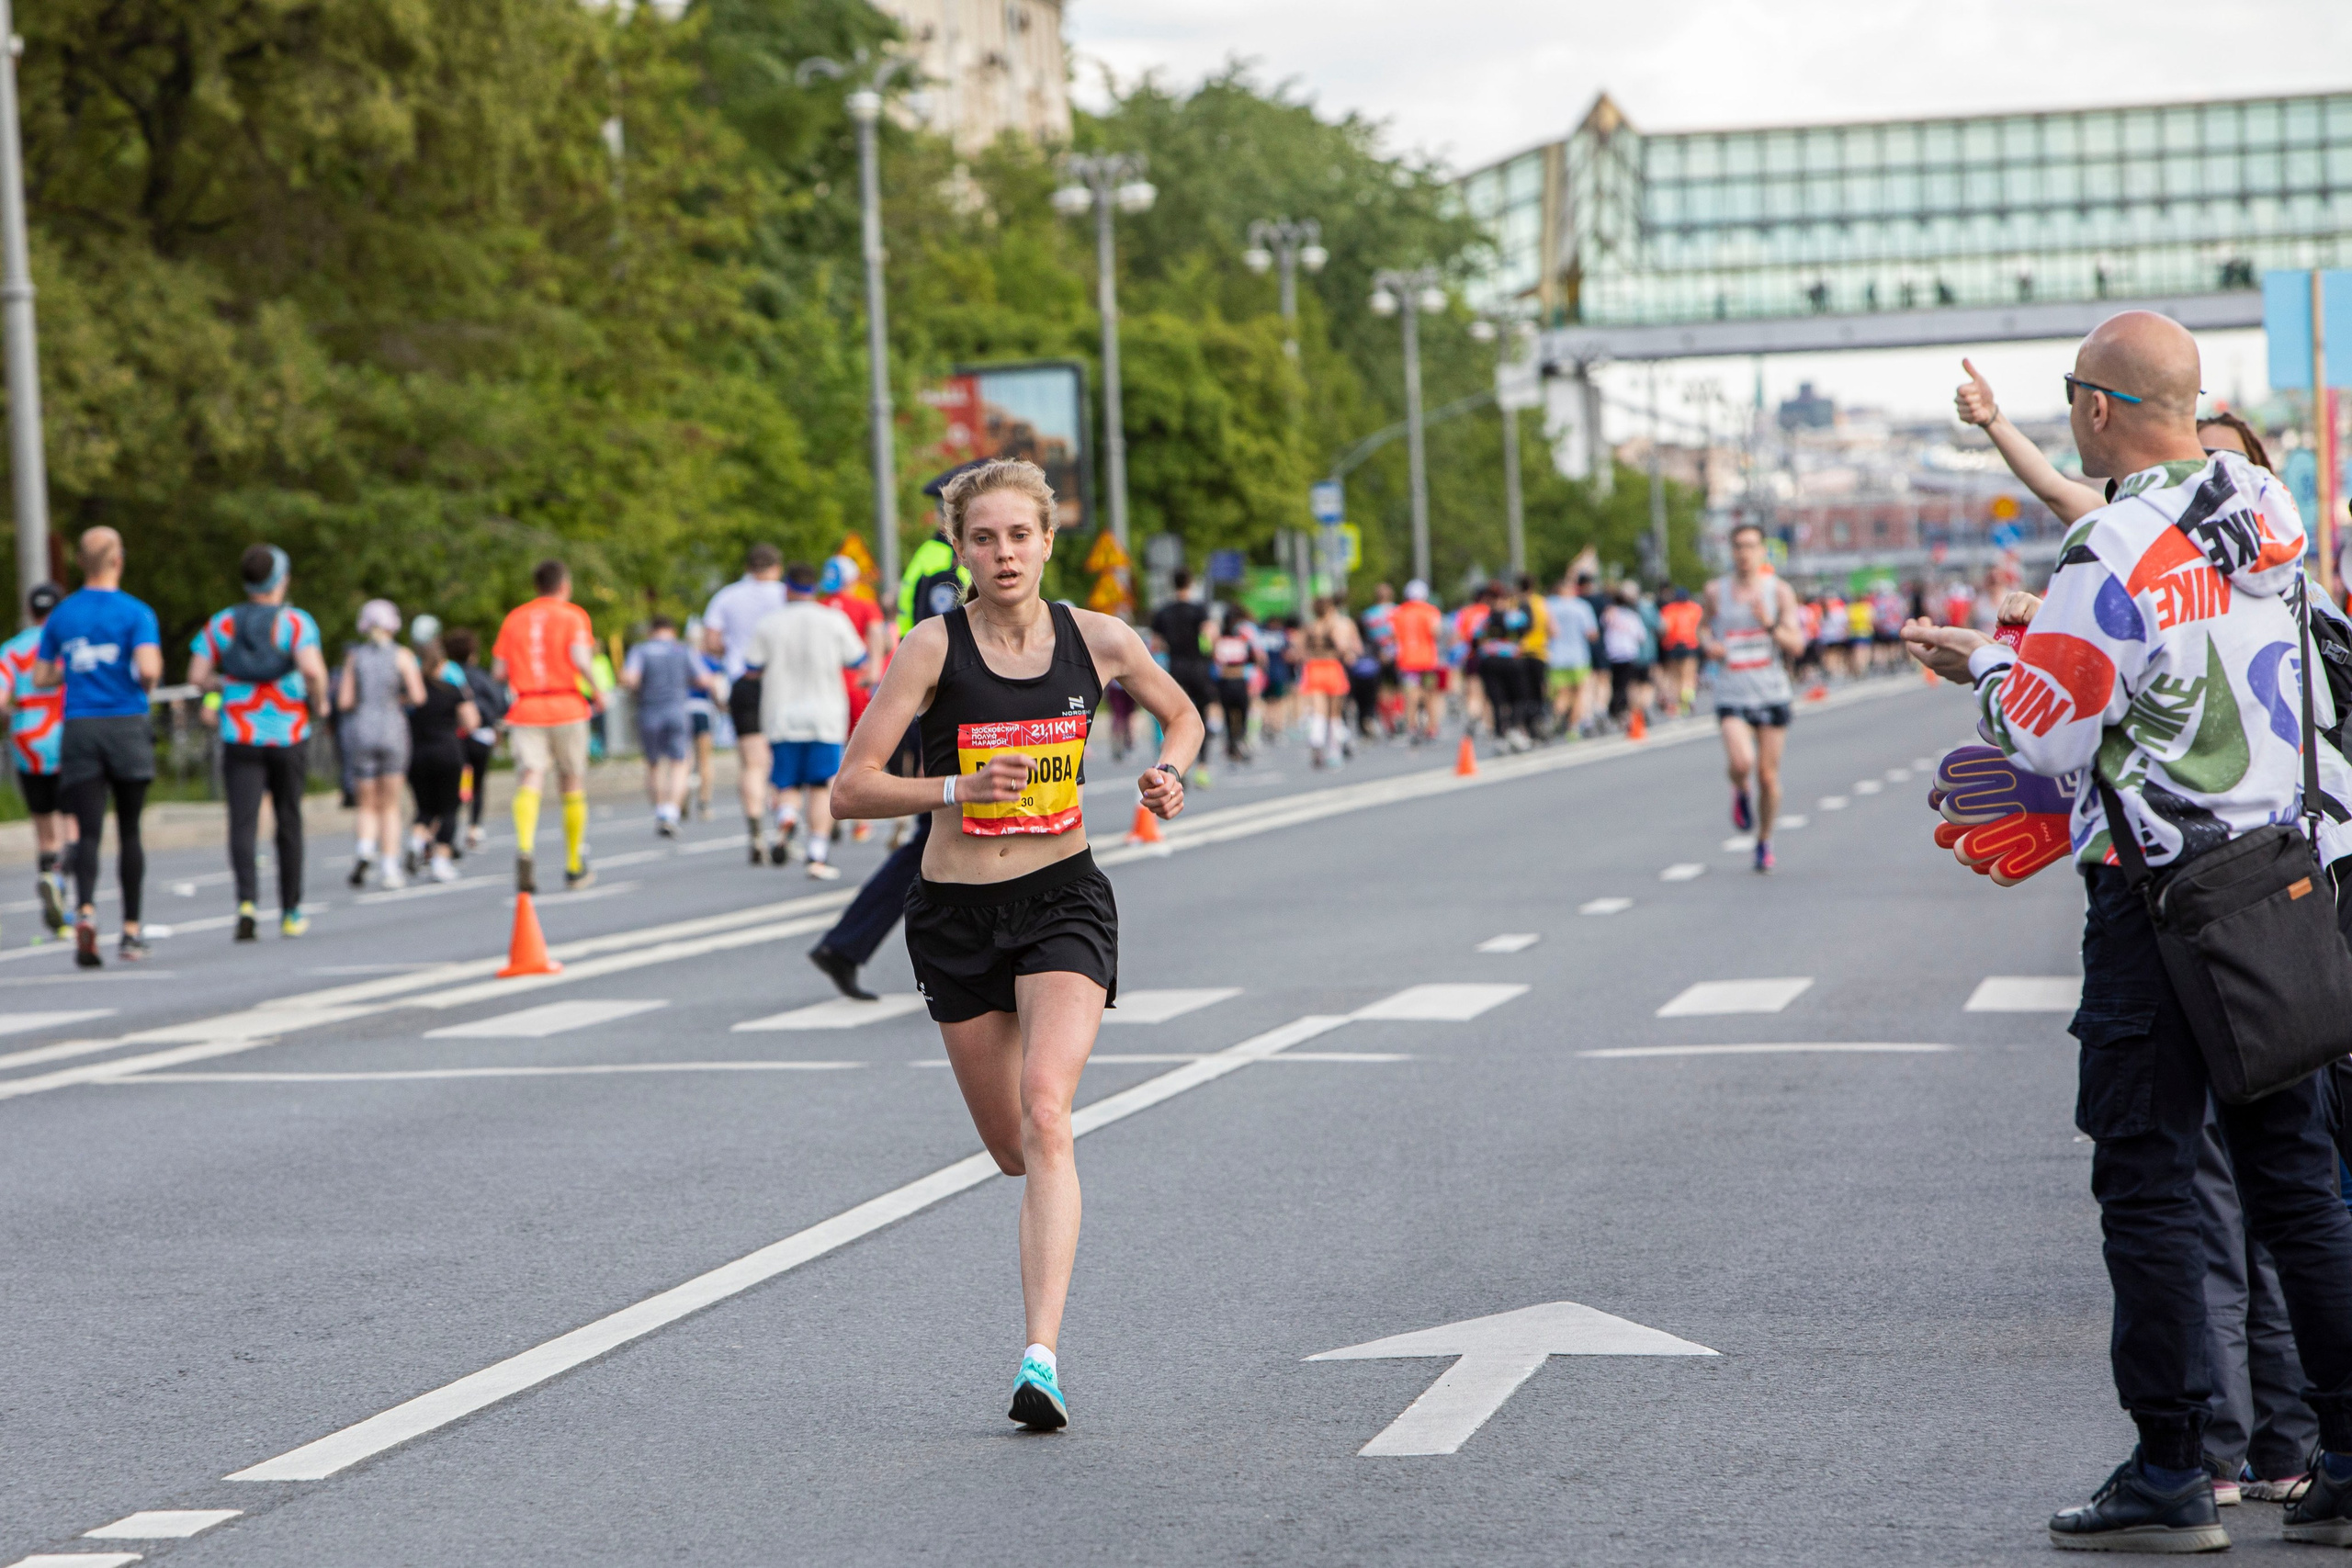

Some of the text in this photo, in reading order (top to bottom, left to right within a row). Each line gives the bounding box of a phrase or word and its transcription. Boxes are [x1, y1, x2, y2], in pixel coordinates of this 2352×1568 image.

[2198, 507, 2261, 575] IKE
[2148, 565, 2227, 631] NIKE
[971, 724, 1020, 734] МОСКОВСКИЙ
[1031, 722, 1053, 737] 21,1
[2129, 671, 2207, 754] NIKE
[1021, 796, 1034, 807] 30
